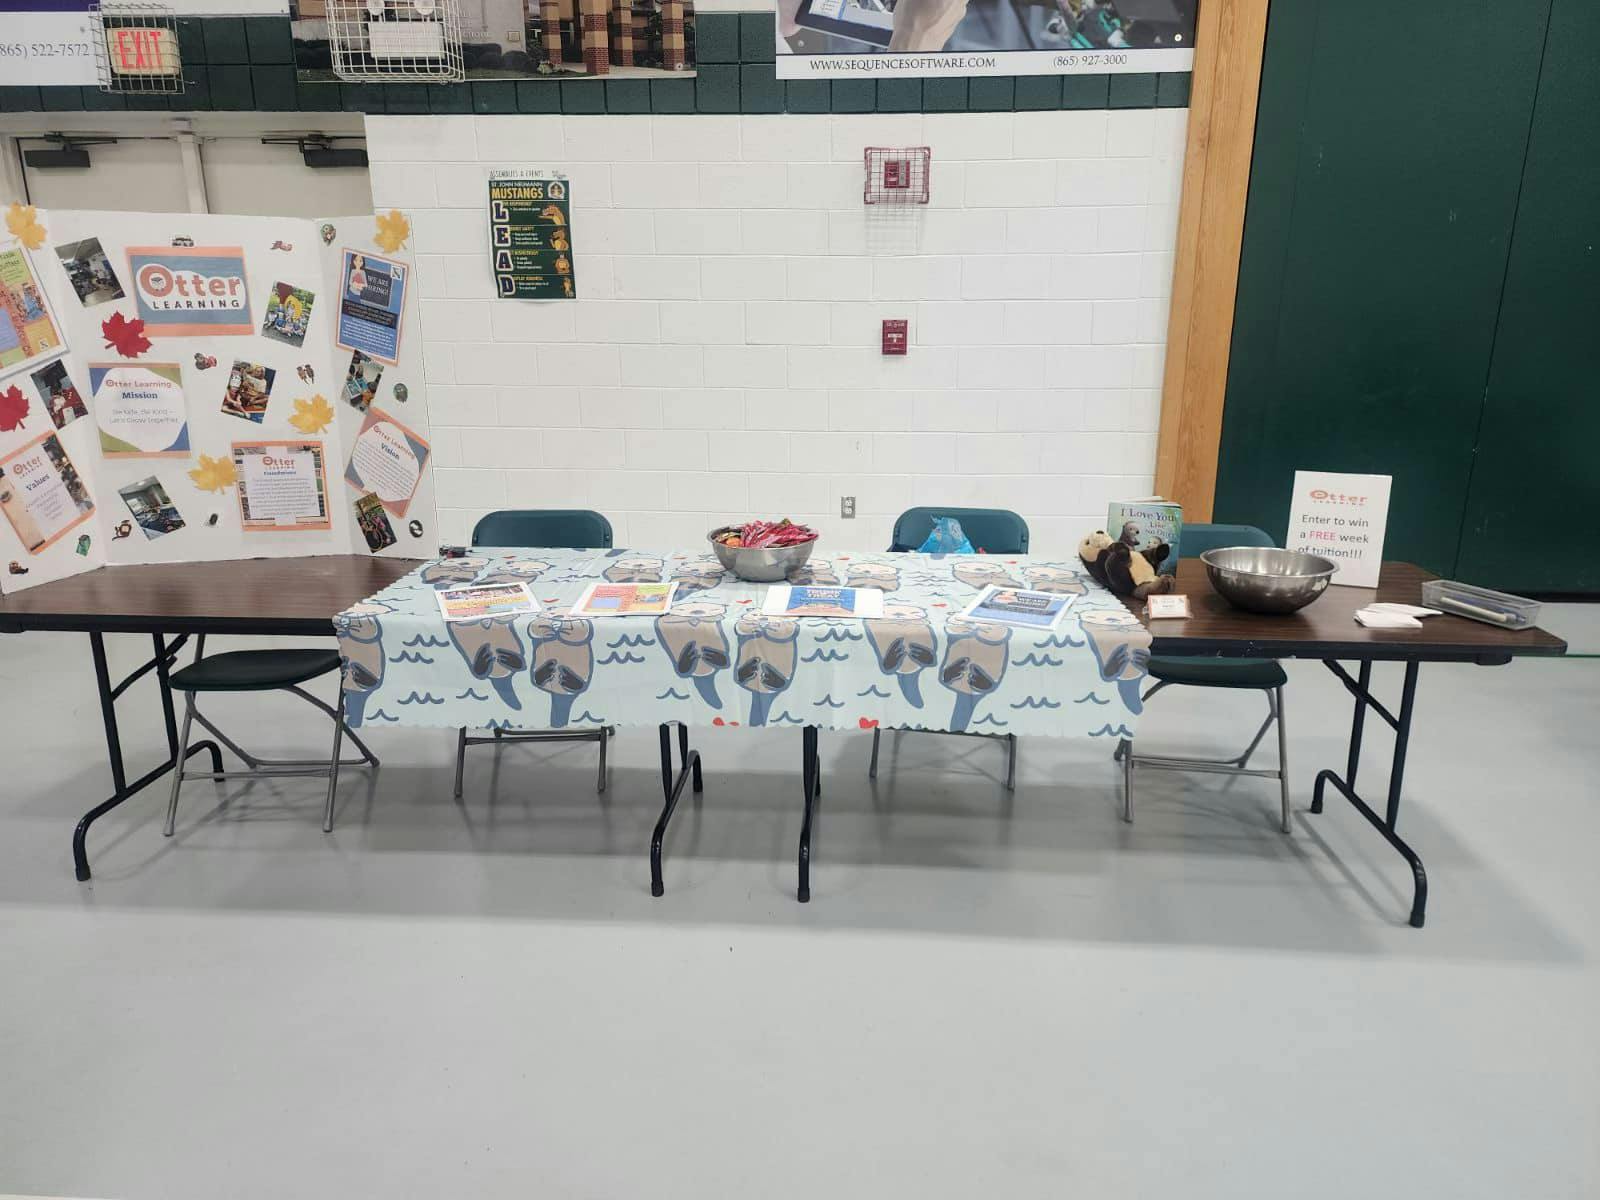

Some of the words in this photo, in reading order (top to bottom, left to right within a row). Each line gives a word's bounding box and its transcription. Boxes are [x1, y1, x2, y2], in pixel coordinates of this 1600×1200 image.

[31, 43, 90, 57] 522-7572
[117, 31, 162, 70] EXIT
[809, 57, 996, 72] WWW.SEQUENCESOFTWARE.COM
[1053, 55, 1079, 68] (865)
[1081, 54, 1128, 66] 927-3000
[491, 187, 544, 199] MUSTANGS
[140, 265, 241, 298] Otter
[152, 299, 240, 310] LEARNING
[105, 379, 132, 388] Otter
[134, 380, 172, 389] Learning
[122, 391, 158, 400] Mission
[381, 442, 400, 460] Vision
[13, 456, 41, 475] Otter
[263, 456, 295, 466] Otter
[26, 473, 50, 491] Values
[1310, 490, 1368, 502] Otter
[1121, 508, 1125, 517] I
[1129, 508, 1154, 519] Love
[1156, 511, 1175, 522] You
[1302, 514, 1332, 526] Enter
[1334, 517, 1345, 526] to
[1349, 518, 1369, 528] win
[1300, 531, 1306, 539] a
[1309, 530, 1336, 541] FREE
[1340, 534, 1369, 544] week
[1298, 545, 1309, 555] of
[1313, 546, 1362, 559] tuition!!!
